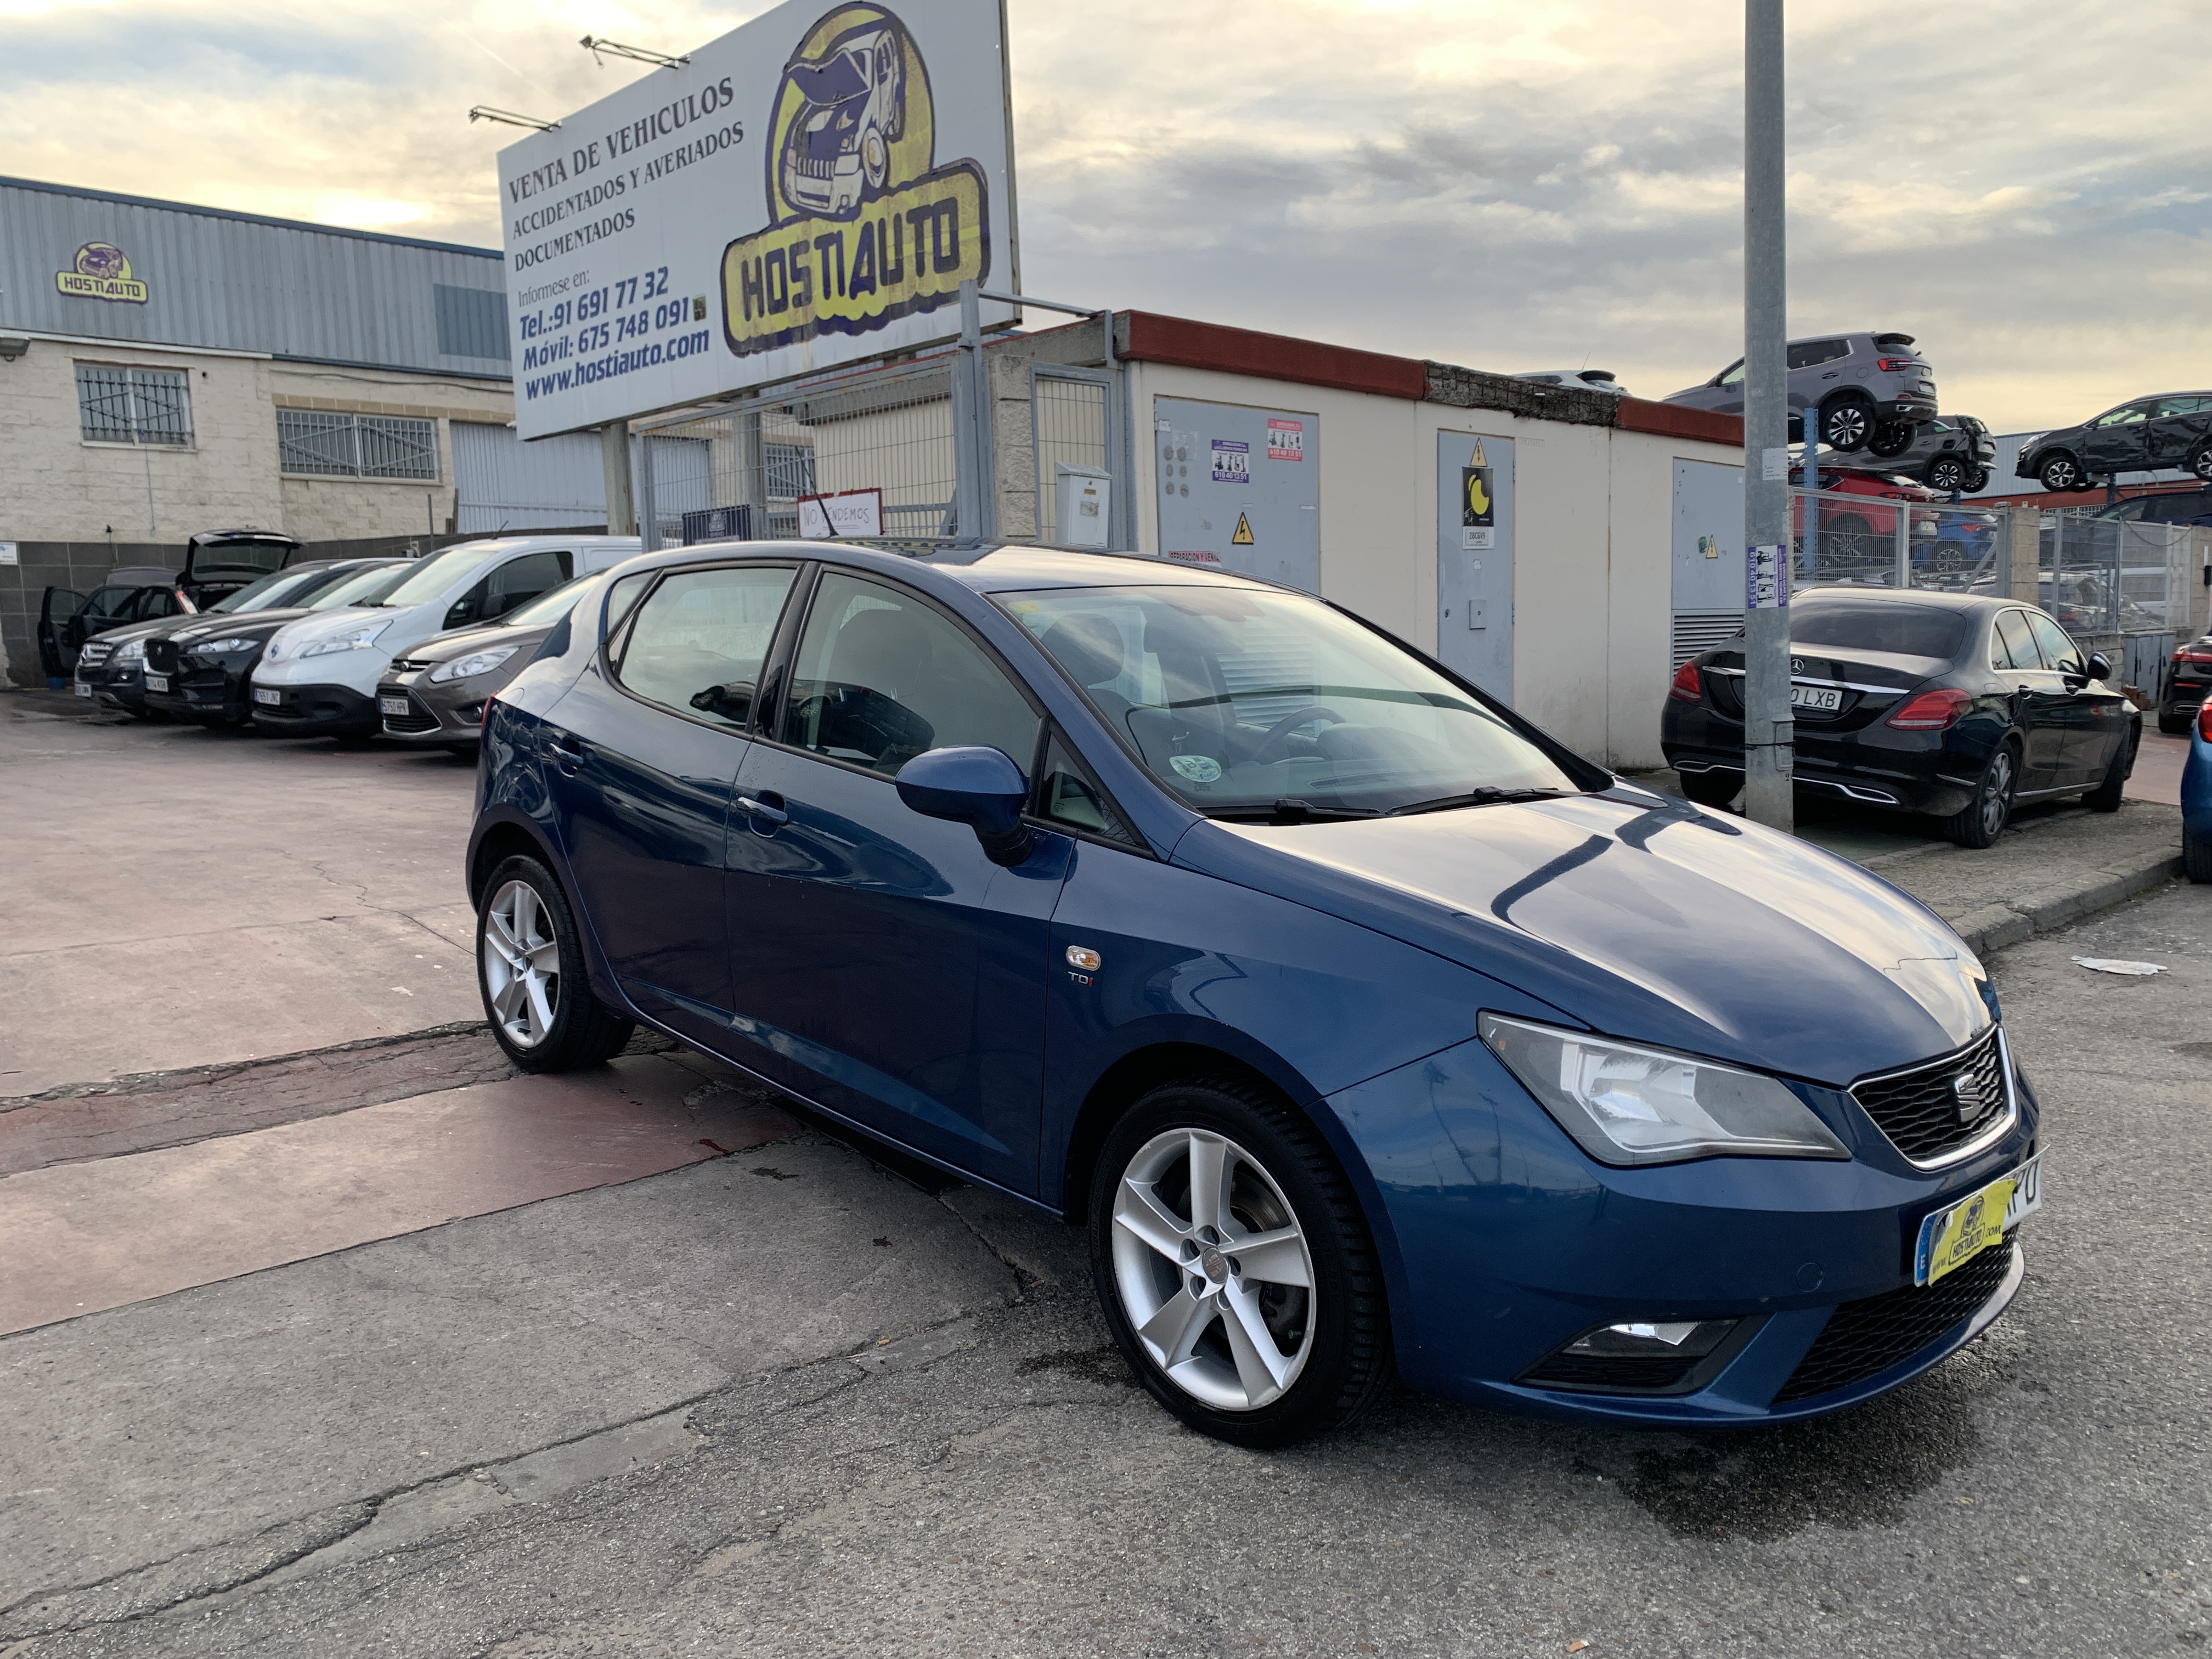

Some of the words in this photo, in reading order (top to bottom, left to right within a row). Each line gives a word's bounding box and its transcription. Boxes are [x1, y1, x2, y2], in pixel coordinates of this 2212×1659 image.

[509, 158, 568, 204] VENTA
[572, 141, 601, 177] DE
[605, 76, 734, 160] VEHICULOS
[512, 175, 625, 240] ACCIDENTADOS
[629, 167, 641, 190] Y
[644, 121, 744, 184] AVERIADOS
[515, 208, 636, 272] DOCUMENTADOS
[741, 196, 960, 322] HOSTIAUTO
[64, 276, 140, 297] HOSTIAUTO
[518, 277, 570, 308] Informese
[573, 270, 590, 289] en:
[578, 286, 609, 321] 691
[615, 276, 638, 309] 77
[643, 266, 668, 301] 32
[523, 335, 574, 371] Móvil:
[578, 321, 610, 354] 675
[616, 309, 649, 343] 748
[655, 296, 689, 330] 091
[526, 329, 710, 400] www.hostiauto.com
[804, 506, 818, 527] NO
[1200, 553, 1204, 562] Y
[1750, 570, 1756, 581] 40
[1751, 582, 1756, 593] 13
[1750, 594, 1756, 605] 51
[1803, 690, 1836, 708] LXB
[1068, 971, 1093, 986] TDI
[1920, 1254, 1926, 1270] E
